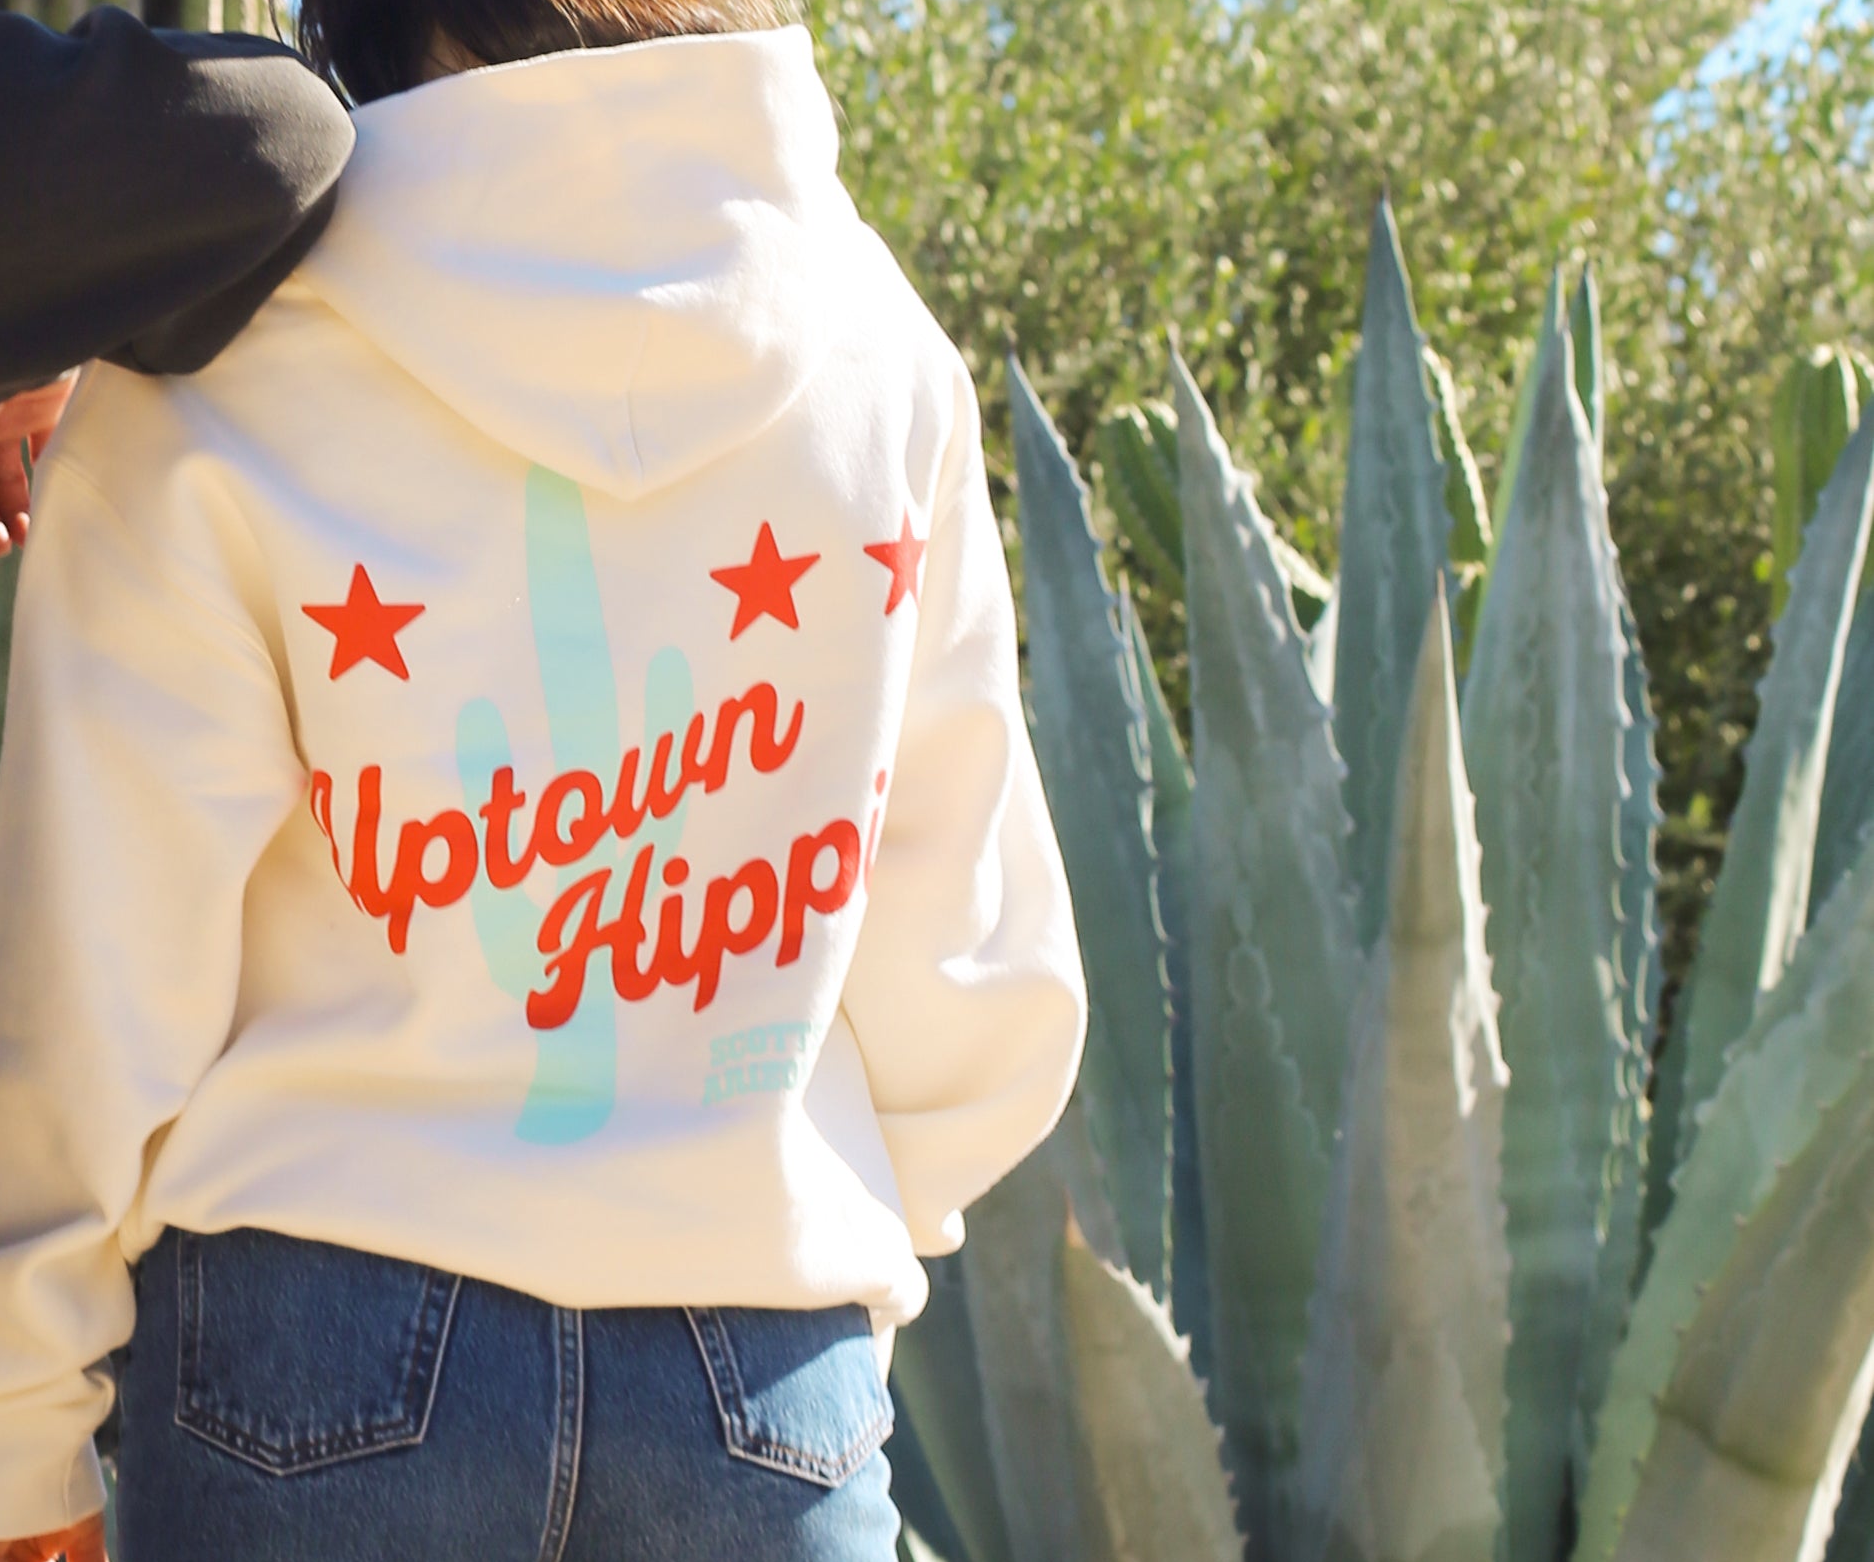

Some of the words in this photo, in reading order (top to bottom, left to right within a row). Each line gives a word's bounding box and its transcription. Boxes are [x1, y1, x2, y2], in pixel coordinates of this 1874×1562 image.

[309, 681, 805, 956] Uptown
[709, 1019, 820, 1069] SCOTT
[701, 1056, 806, 1110] ARIZO
